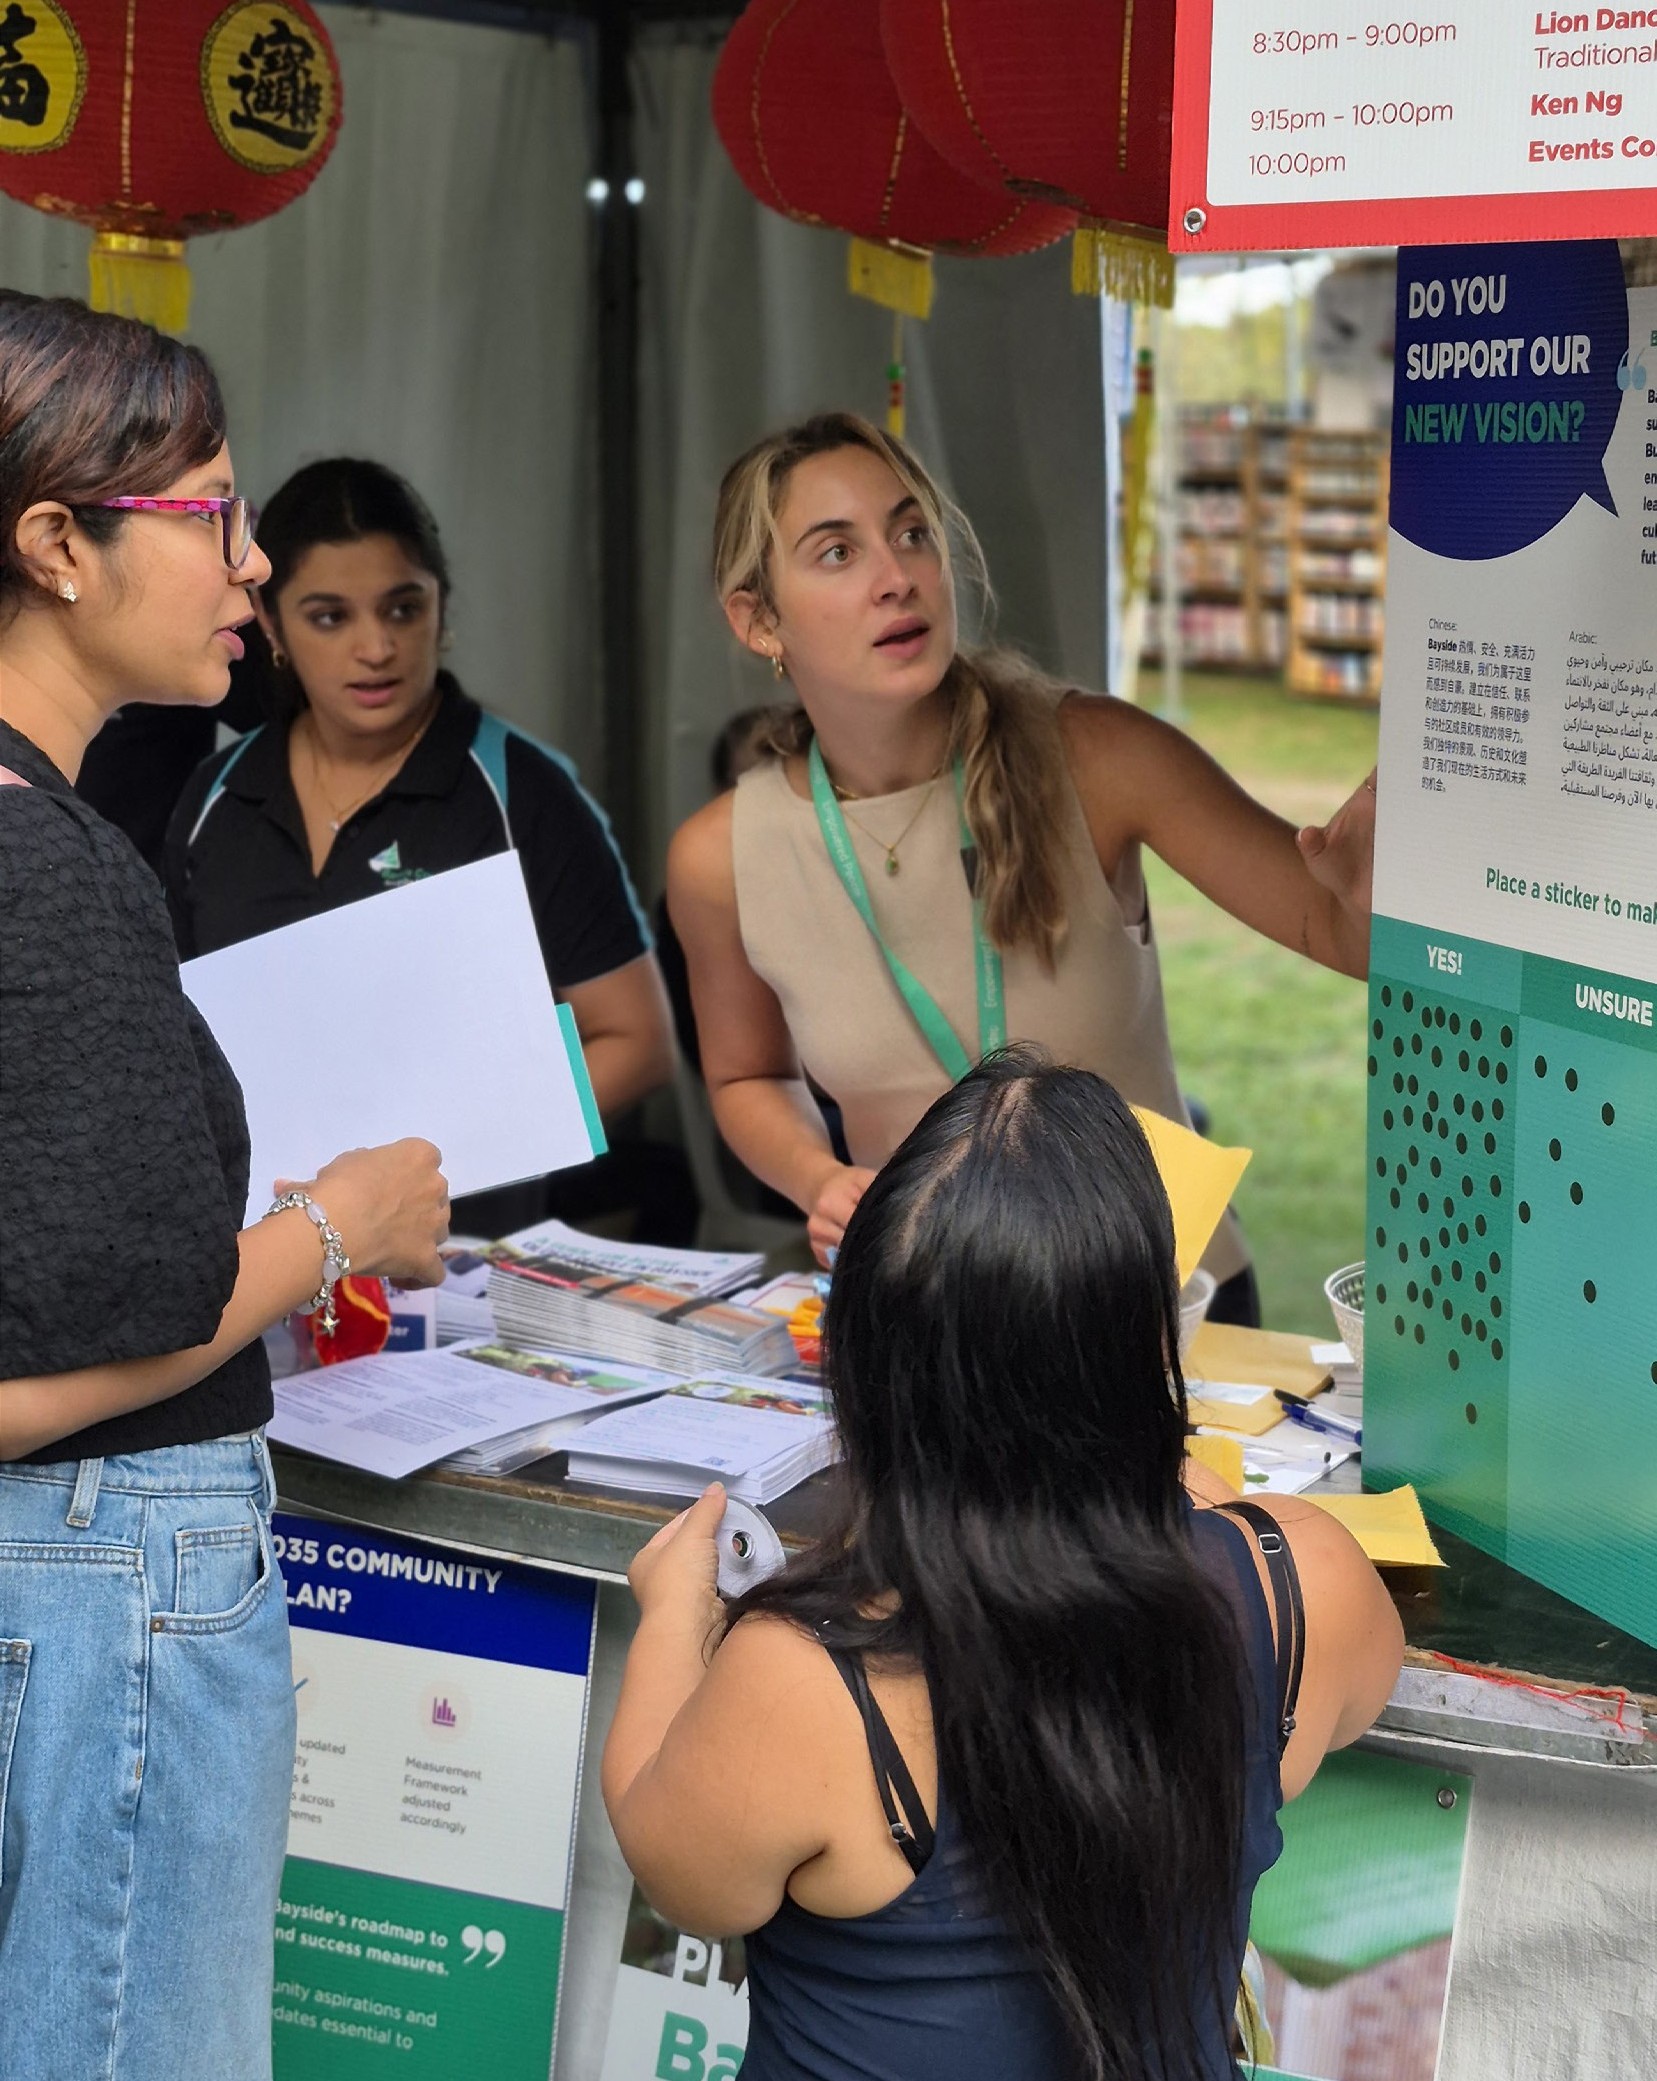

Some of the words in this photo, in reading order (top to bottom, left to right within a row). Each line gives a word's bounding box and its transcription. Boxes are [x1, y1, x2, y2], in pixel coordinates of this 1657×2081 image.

[1535, 10, 1589, 35] Lion
[1596, 8, 1657, 31] Danc
[1253, 30, 1338, 55] 8:30pm
[1365, 21, 1457, 48] 9:00pm
[1534, 38, 1657, 69] Traditional
[1251, 108, 1325, 133] 9:15pm
[1352, 102, 1453, 128] 10:00pm
[1531, 93, 1582, 117] Ken
[1586, 91, 1623, 117] Ng
[1249, 152, 1346, 177] 10:00pm
[1528, 138, 1614, 163] Events
[1621, 136, 1657, 159] Co
[1409, 280, 1445, 319] DO
[1451, 274, 1506, 316] YOU
[1406, 338, 1524, 380] SUPPORT
[1530, 335, 1591, 376] OUR
[1405, 403, 1467, 443] NEW
[1473, 401, 1585, 443] VISION?
[1428, 638, 1457, 652] Bayside
[1486, 867, 1527, 896] Place
[1531, 881, 1541, 899] a
[1545, 882, 1600, 912] sticker
[1604, 893, 1622, 917] to
[1426, 944, 1463, 976] YES!
[1575, 983, 1654, 1027] UNSURE
[327, 1544, 503, 1594] COMMUNITY
[299, 1739, 346, 1755] updated
[405, 1756, 482, 1780] Measurement
[299, 1792, 335, 1808] across
[404, 1774, 468, 1796] Framework
[402, 1794, 451, 1812] adjusted
[400, 1812, 466, 1834] accordingly
[351, 1916, 425, 1945] roadmap
[430, 1931, 448, 1948] to
[300, 1932, 362, 1957] success
[366, 1946, 449, 1976] measures.
[314, 1988, 402, 2021] aspirations
[405, 2010, 438, 2028] and
[321, 2017, 392, 2044] essential
[396, 2032, 413, 2050] to
